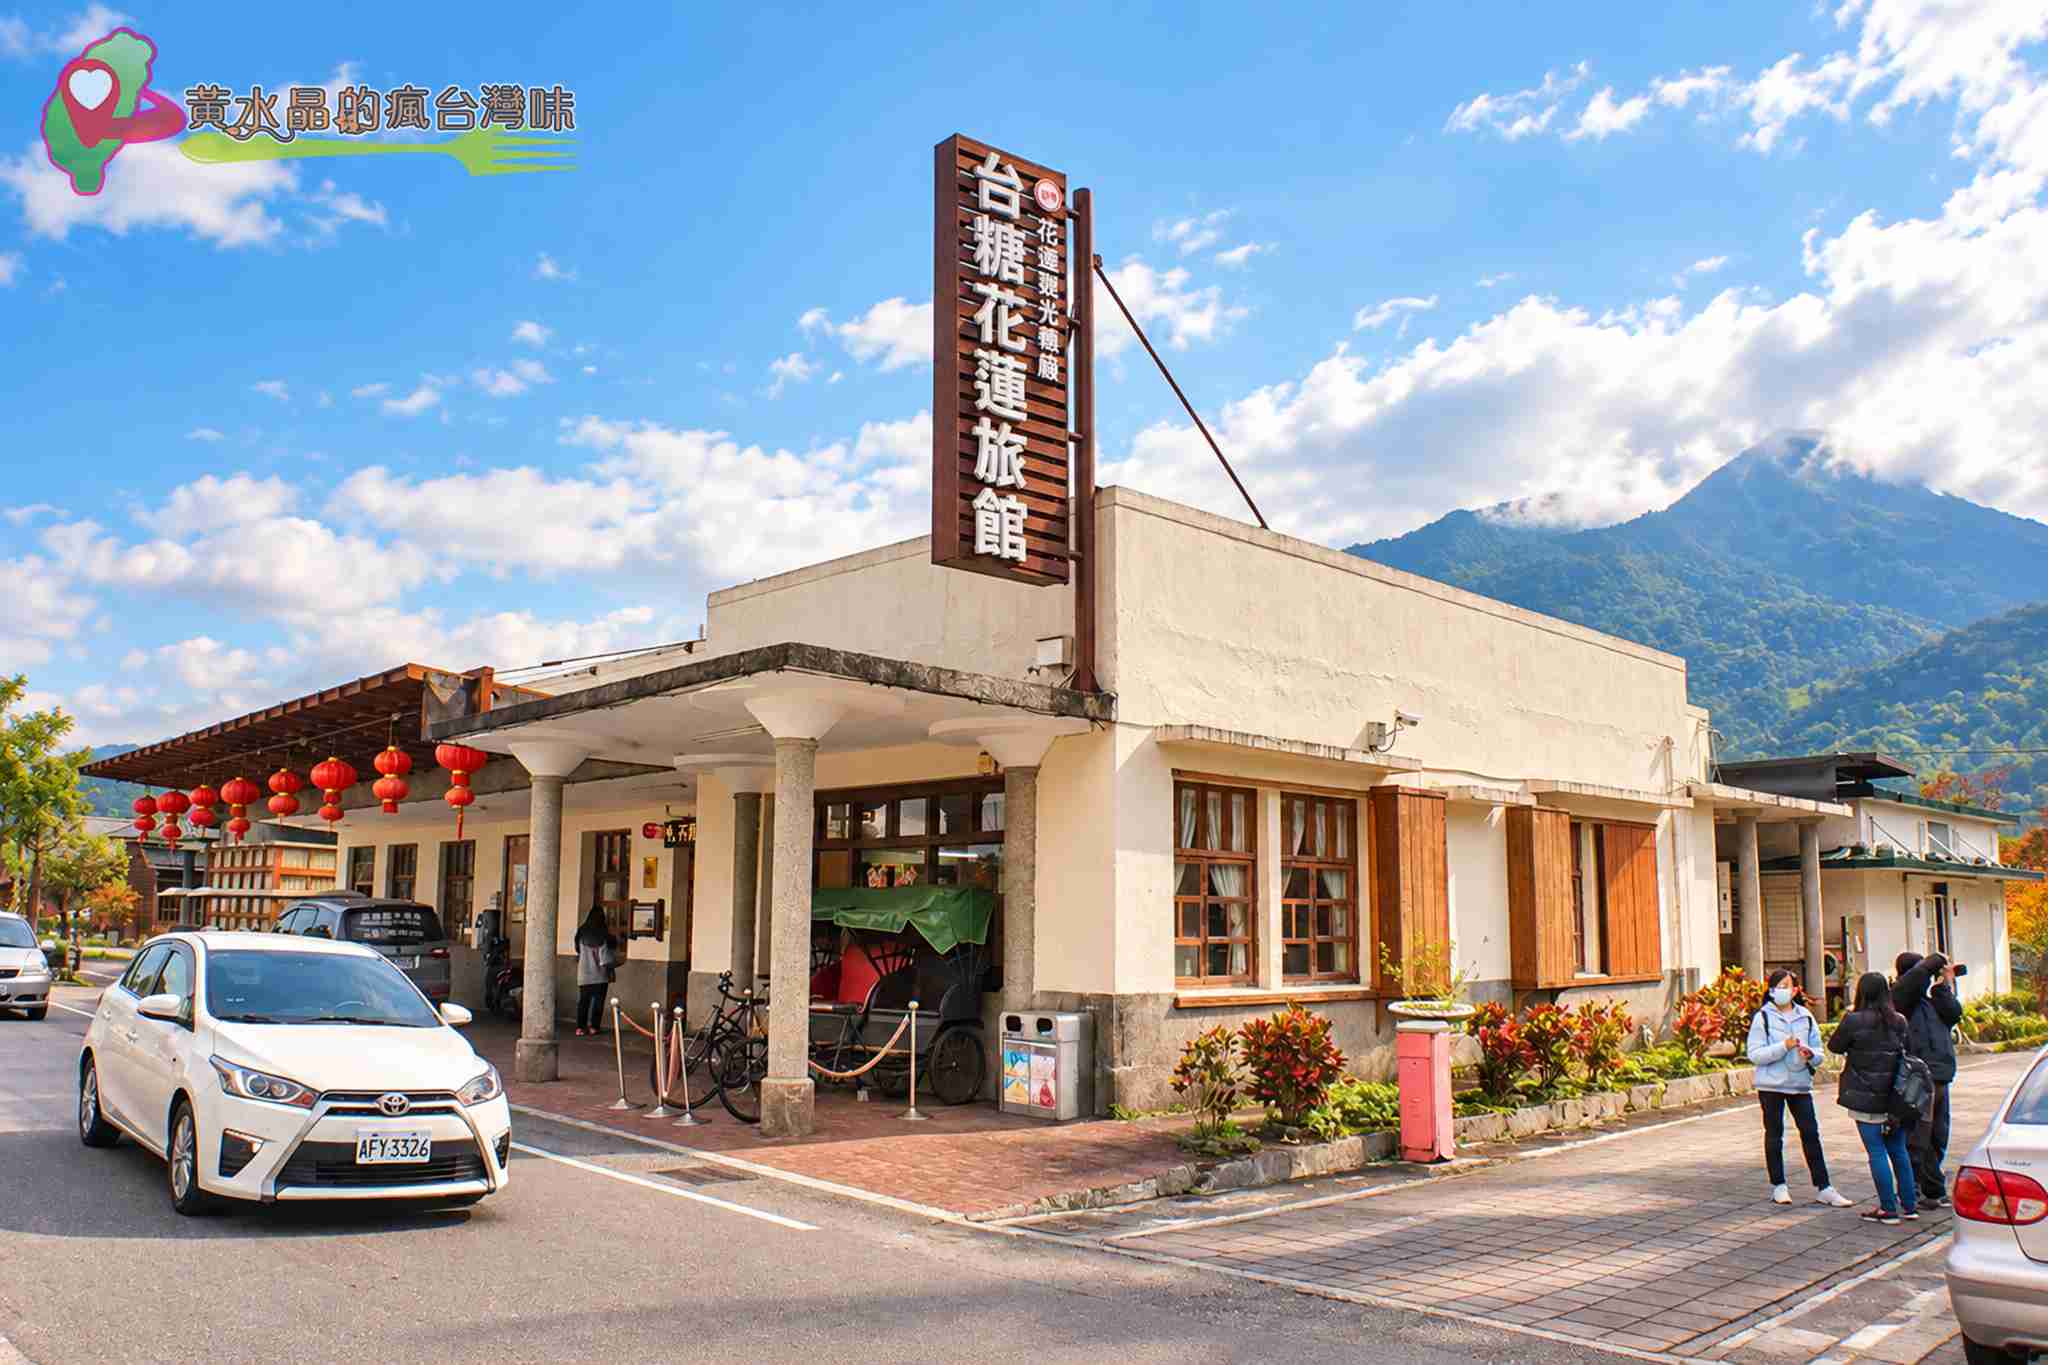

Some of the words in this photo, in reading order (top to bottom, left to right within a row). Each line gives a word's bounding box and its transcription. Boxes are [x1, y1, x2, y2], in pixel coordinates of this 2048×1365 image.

[972, 150, 1028, 562] 台糖花蓮旅館
